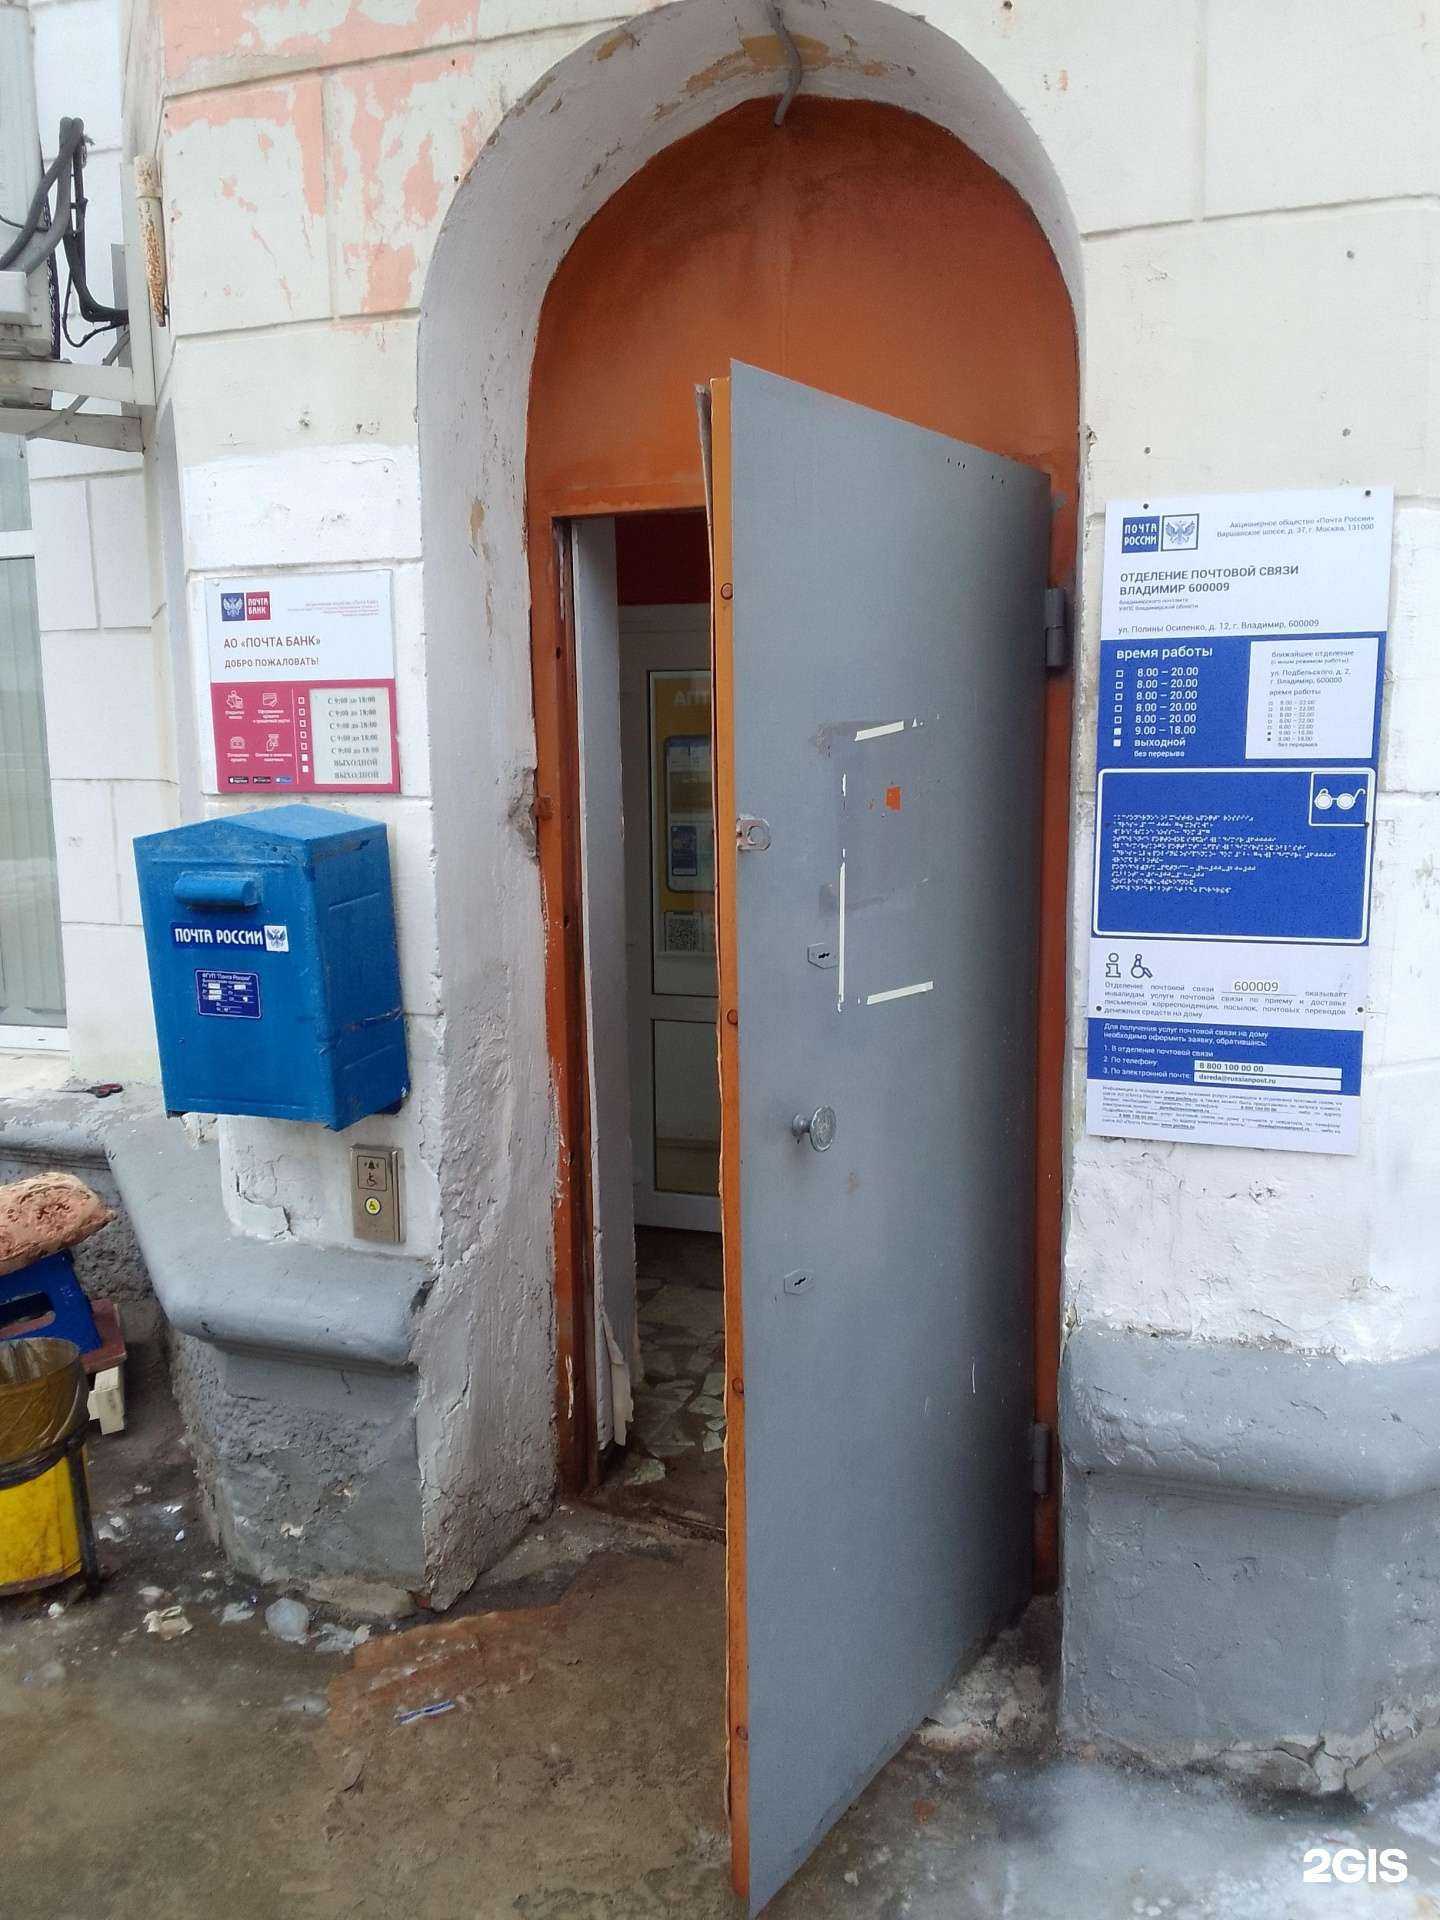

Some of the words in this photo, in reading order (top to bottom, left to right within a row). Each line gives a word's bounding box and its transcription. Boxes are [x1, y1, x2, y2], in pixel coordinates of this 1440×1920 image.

[1230, 519, 1277, 529] Акционерное
[1279, 518, 1314, 527] общество
[1124, 523, 1157, 535] ПОЧТА
[1217, 529, 1260, 538] Варшавское
[1124, 535, 1157, 546] РОССИИ
[1120, 570, 1189, 583] ОТДЕЛЕНИЕ
[1191, 564, 1256, 579] ПОЧТОВОЙ
[1259, 564, 1299, 576] СВЯЗИ
[1120, 583, 1186, 596] ВЛАДИМИР
[1188, 582, 1230, 593] 600009
[247, 597, 269, 606] ПОЧТА
[247, 606, 267, 615] БАНК
[1118, 627, 1129, 635] ул.
[1131, 625, 1164, 633] Полины
[1165, 624, 1207, 632] Осипенко,
[1219, 622, 1231, 630] 12,
[1241, 621, 1286, 630] Владимир,
[1288, 619, 1320, 628] 600009
[223, 637, 238, 649] АО
[240, 636, 283, 648] «ПОЧТА
[285, 634, 321, 647] БАНК»
[1116, 649, 1159, 661] время
[1162, 645, 1213, 660] работы
[224, 658, 253, 669] ДОБРО
[255, 656, 319, 667] ПОЖАЛОВАТЬ!
[1137, 668, 1158, 677] 8.00
[1171, 667, 1198, 676] 20.00
[1137, 679, 1158, 688] 8.00
[1171, 679, 1198, 688] 20.00
[1136, 691, 1157, 700] 8.00
[1170, 691, 1197, 700] 20.00
[1294, 688, 1321, 696] работы
[1135, 703, 1157, 712] 8.00
[1169, 702, 1196, 711] 20.00
[1135, 715, 1156, 723] 8.00
[1169, 714, 1196, 723] 20.00
[1135, 726, 1156, 735] 9.00
[1169, 726, 1196, 734] 18.00
[1134, 738, 1186, 748] выходной
[334, 759, 378, 767] ВЫХОДНОЙ
[334, 771, 379, 779] ВЫХОДНОЙ
[174, 928, 213, 944] ПОЧТА
[216, 929, 264, 945] РОССИИ
[1104, 981, 1143, 990] Отделение
[1150, 983, 1185, 991] почтовой
[1234, 981, 1279, 992] 600009
[1104, 999, 1148, 1007] письменной
[1223, 1004, 1258, 1012] посылок,
[1262, 1006, 1300, 1014] почтовых
[1304, 1008, 1346, 1016] переводов
[1104, 1023, 1118, 1031] Для
[1119, 1024, 1158, 1032] получения
[1179, 1027, 1214, 1036] почтовой
[1248, 1031, 1269, 1039] дому
[1103, 1032, 1148, 1040] необходимо
[1148, 1034, 1187, 1042] оформить
[1187, 1037, 1215, 1046] заявку,
[1215, 1038, 1268, 1047] обратившись:
[1117, 1046, 1155, 1054] отделение
[1156, 1048, 1191, 1056] почтовой
[1206, 1062, 1222, 1070] 800
[1224, 1063, 1239, 1071] 100
[1110, 1067, 1121, 1075] По
[1121, 1068, 1168, 1078] электронной
